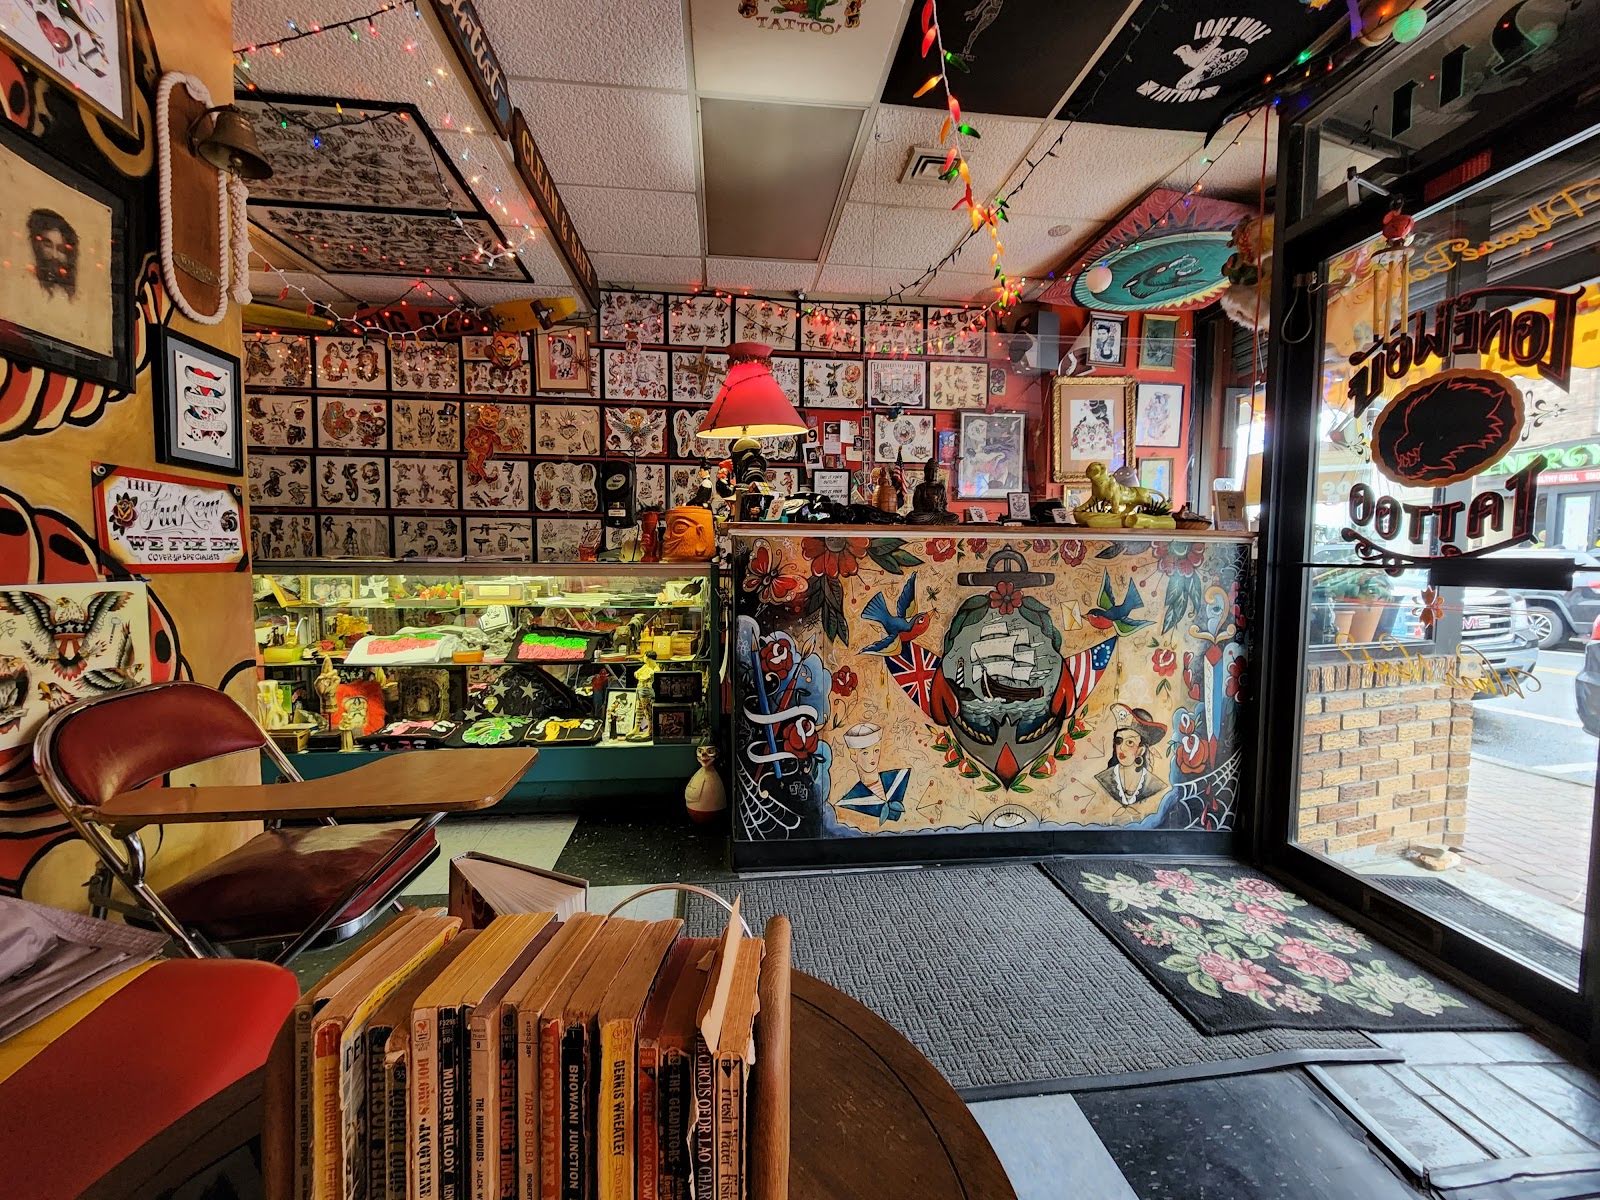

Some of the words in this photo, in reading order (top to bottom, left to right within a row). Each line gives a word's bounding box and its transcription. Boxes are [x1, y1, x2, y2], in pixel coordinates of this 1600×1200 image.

[756, 16, 842, 35] TATTOO!
[1194, 16, 1238, 40] LONE
[1229, 16, 1272, 45] WOLF
[1150, 85, 1201, 103] TATTOO
[522, 130, 559, 225] CLEAN
[571, 231, 592, 287] SAFE
[126, 535, 164, 551] WE
[168, 536, 206, 551] FIX
[209, 537, 240, 551] EM
[301, 1041, 309, 1054] THE
[542, 1035, 555, 1064] ICE
[301, 1055, 309, 1101] PENETRATOR
[324, 1066, 337, 1088] THE
[370, 1044, 385, 1141] JEFFERSON
[417, 1060, 431, 1117] DOLORES
[443, 1069, 455, 1121] MURDER
[501, 1059, 516, 1107] SEVEN
[542, 1068, 555, 1111] COLD
[569, 1064, 579, 1124] BHOWANI
[613, 1060, 625, 1099] DENNIS
[669, 1074, 681, 1093] THE
[697, 1054, 712, 1097] CIRCUS
[389, 1087, 405, 1143] ROBERT
[475, 1098, 485, 1112] THE
[524, 1090, 534, 1125] TARAS
[642, 1091, 653, 1112] THE
[697, 1099, 712, 1115] OF
[721, 1087, 739, 1123] Fresh
[301, 1104, 309, 1141] DEMENTED
[324, 1092, 337, 1156] FORBIDDEN
[475, 1115, 485, 1162] HUMANOIDS
[501, 1110, 516, 1151] LONG
[542, 1116, 555, 1138] IN
[613, 1100, 625, 1156] WHEATLEY
[642, 1115, 653, 1151] BLACK
[669, 1097, 681, 1161] GLADIATORS
[416, 1124, 432, 1199] JACQUELINE
[443, 1124, 455, 1174] MELODY
[524, 1130, 534, 1165] BULBA
[542, 1141, 555, 1187] ALEX
[569, 1129, 579, 1189] JUNCTION
[697, 1138, 712, 1163] LAO
[721, 1128, 739, 1166] Water
[389, 1151, 405, 1193] LOUIS
[475, 1169, 485, 1192] JACK
[501, 1154, 516, 1198] TIMES
[642, 1155, 653, 1200] ARROW
